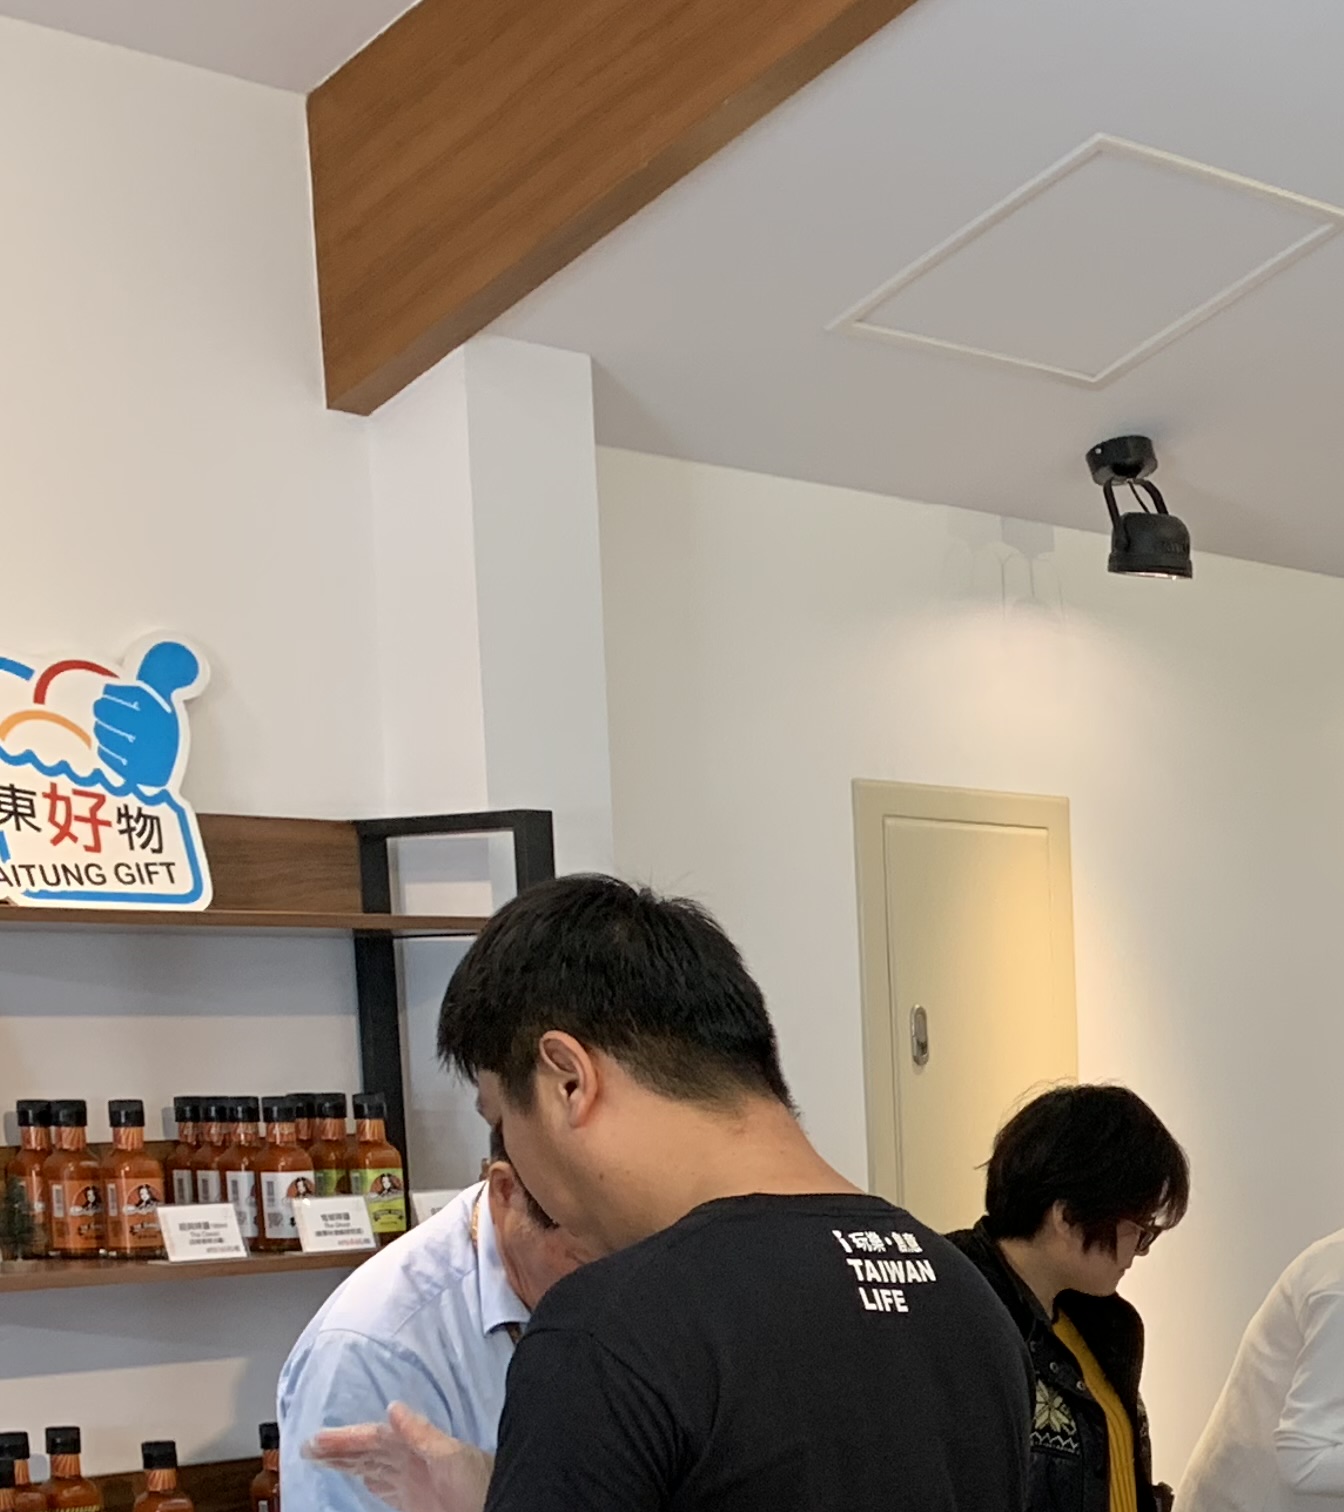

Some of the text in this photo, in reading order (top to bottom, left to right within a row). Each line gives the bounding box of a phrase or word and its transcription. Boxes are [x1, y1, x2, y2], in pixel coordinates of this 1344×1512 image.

[0, 782, 164, 854] 東好物
[114, 862, 175, 885] GIFT
[846, 1258, 937, 1283] TAIWAN
[858, 1287, 909, 1312] LIFE
